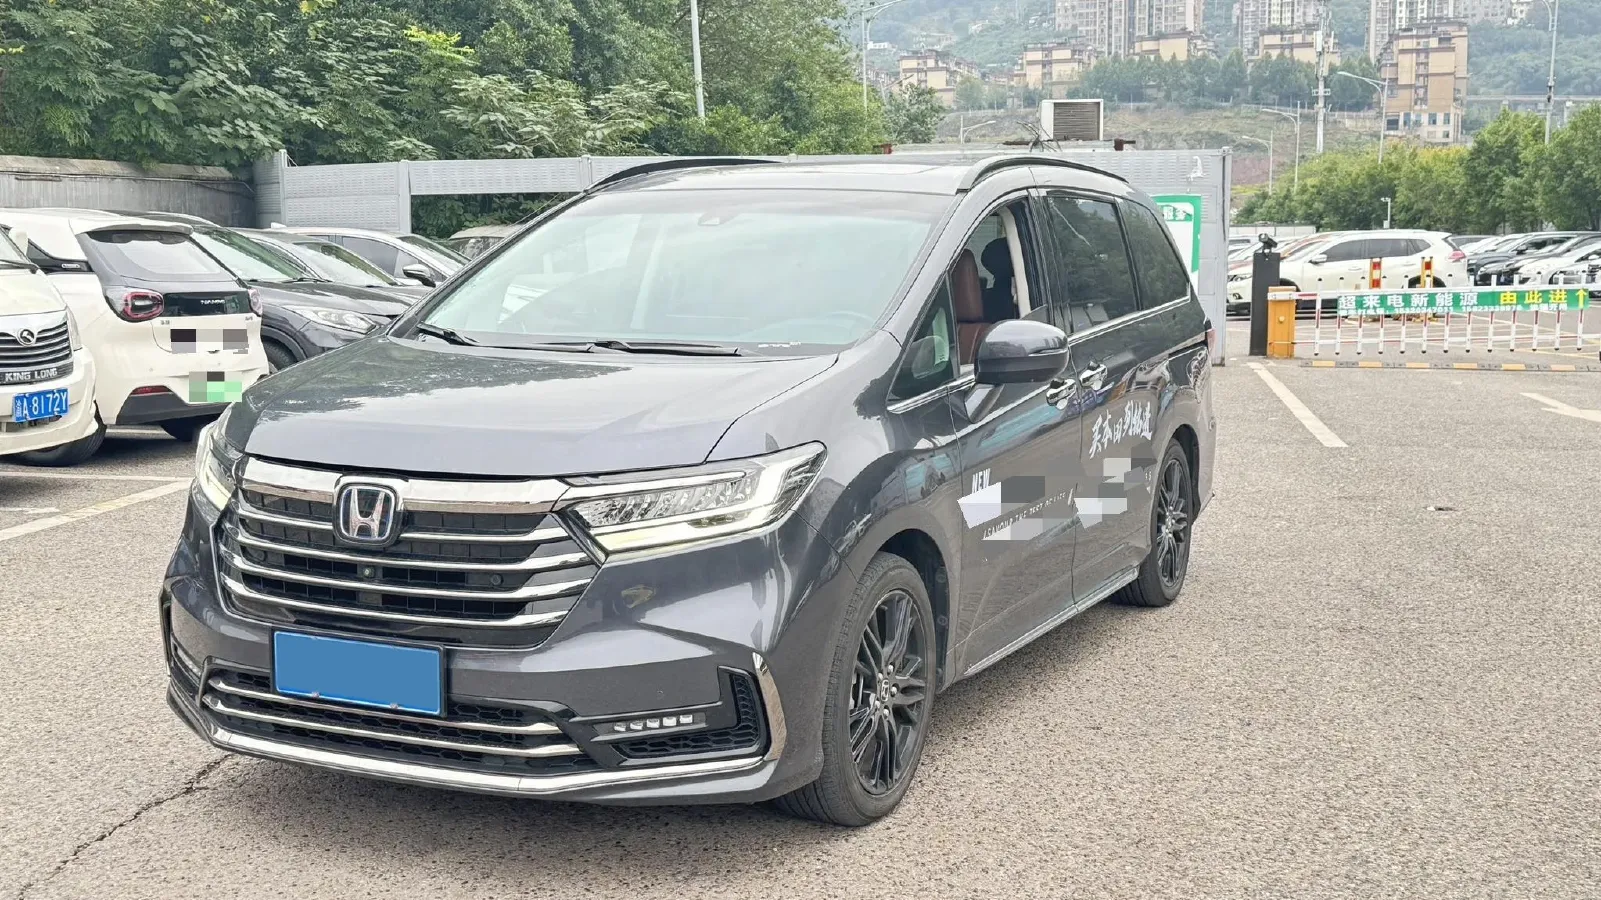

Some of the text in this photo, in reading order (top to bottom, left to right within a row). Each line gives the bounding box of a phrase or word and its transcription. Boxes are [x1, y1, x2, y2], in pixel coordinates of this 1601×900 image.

[1500, 289, 1568, 305] 由此进
[5, 367, 58, 382] KING LONG
[972, 467, 991, 494] NEW
